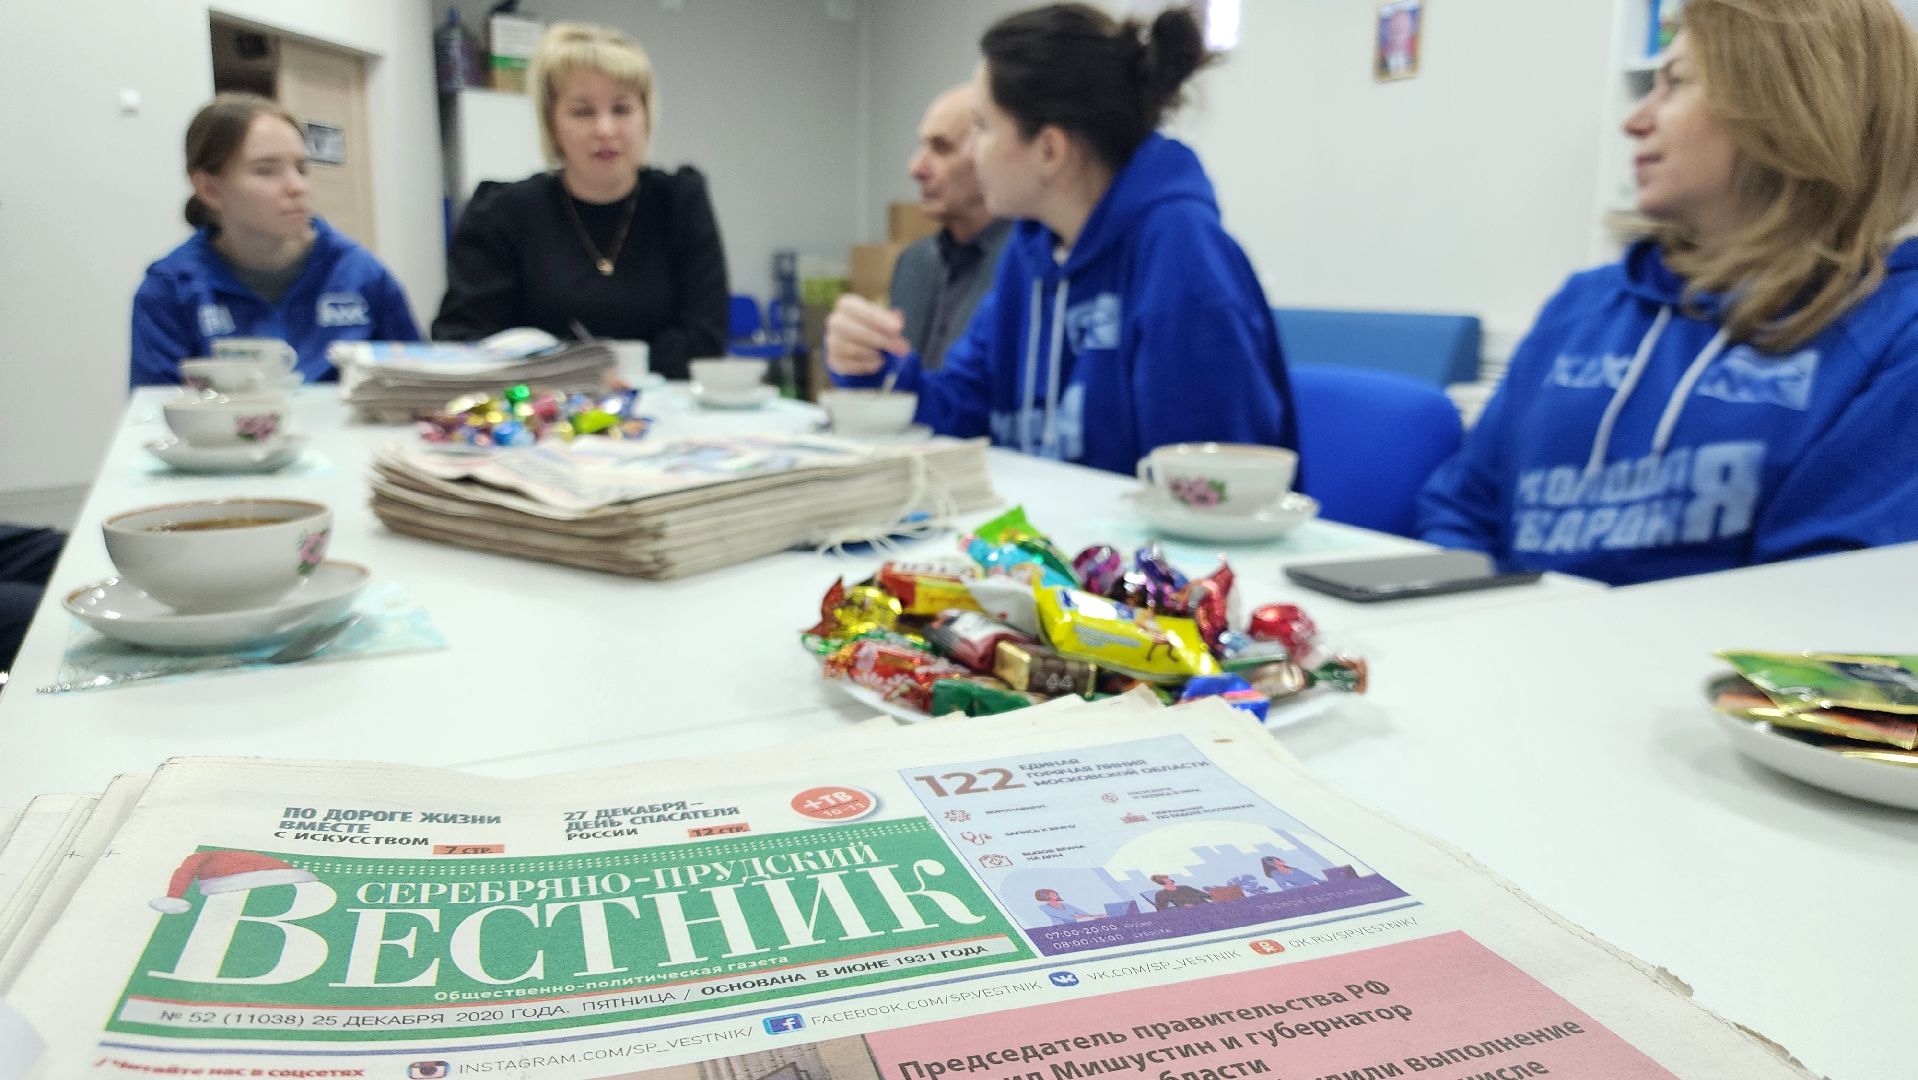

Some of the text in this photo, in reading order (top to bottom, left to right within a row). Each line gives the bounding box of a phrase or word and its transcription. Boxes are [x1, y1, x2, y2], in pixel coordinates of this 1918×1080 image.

[1018, 757, 1080, 771] ЕДИНАЯ
[1026, 759, 1148, 779] ГОРЯЧАЯ ЛИНИЯ
[1033, 760, 1211, 787] МОСКОВСКОЙ ОБЛАСТИ
[913, 766, 1026, 798] 122
[279, 820, 371, 834] ВМЕСТЕ
[282, 807, 502, 824] ПО ДОРОГЕ ЖИЗНИ
[563, 810, 588, 822] 27
[566, 806, 740, 833] ДЕНЬ СПАСАТЕЛЯ
[274, 831, 429, 846] С ИСКУССТВОМ
[567, 828, 639, 841] РОССИИ
[692, 828, 715, 837] 12
[446, 846, 458, 855] 7
[356, 840, 883, 905] СЕРЕБРЯНО-ПРУДСКИЙ
[147, 858, 987, 988] ВЕСТНИК
[160, 1010, 183, 1022] №
[189, 1011, 216, 1023] 52
[223, 1012, 305, 1027] (11038)
[312, 1014, 338, 1026] 25
[342, 1013, 445, 1028] ДЕКАБРЯ
[456, 1009, 504, 1023] 2020
[510, 1004, 571, 1019] ГОДА.
[582, 990, 677, 1012] ПЯТНИЦА
[701, 972, 807, 997] ОСНОВАНА
[816, 969, 830, 979] В
[833, 959, 892, 976] ИЮНЕ
[895, 952, 937, 967] 1931
[941, 945, 989, 960] ГОДА
[433, 955, 789, 1002] Общественно-политическая газета
[897, 979, 1391, 1080] Председатель правительства РФ
[1049, 1003, 1414, 1080] Мишустин и губернатор
[458, 1026, 753, 1075] INSTAGRAM.COM/SP_VESTNIK/
[1403, 1019, 1586, 1072] выполнение
[208, 1068, 247, 1076] нас
[268, 1068, 366, 1079] соцсетях
[1159, 1058, 1272, 1080] бласти
